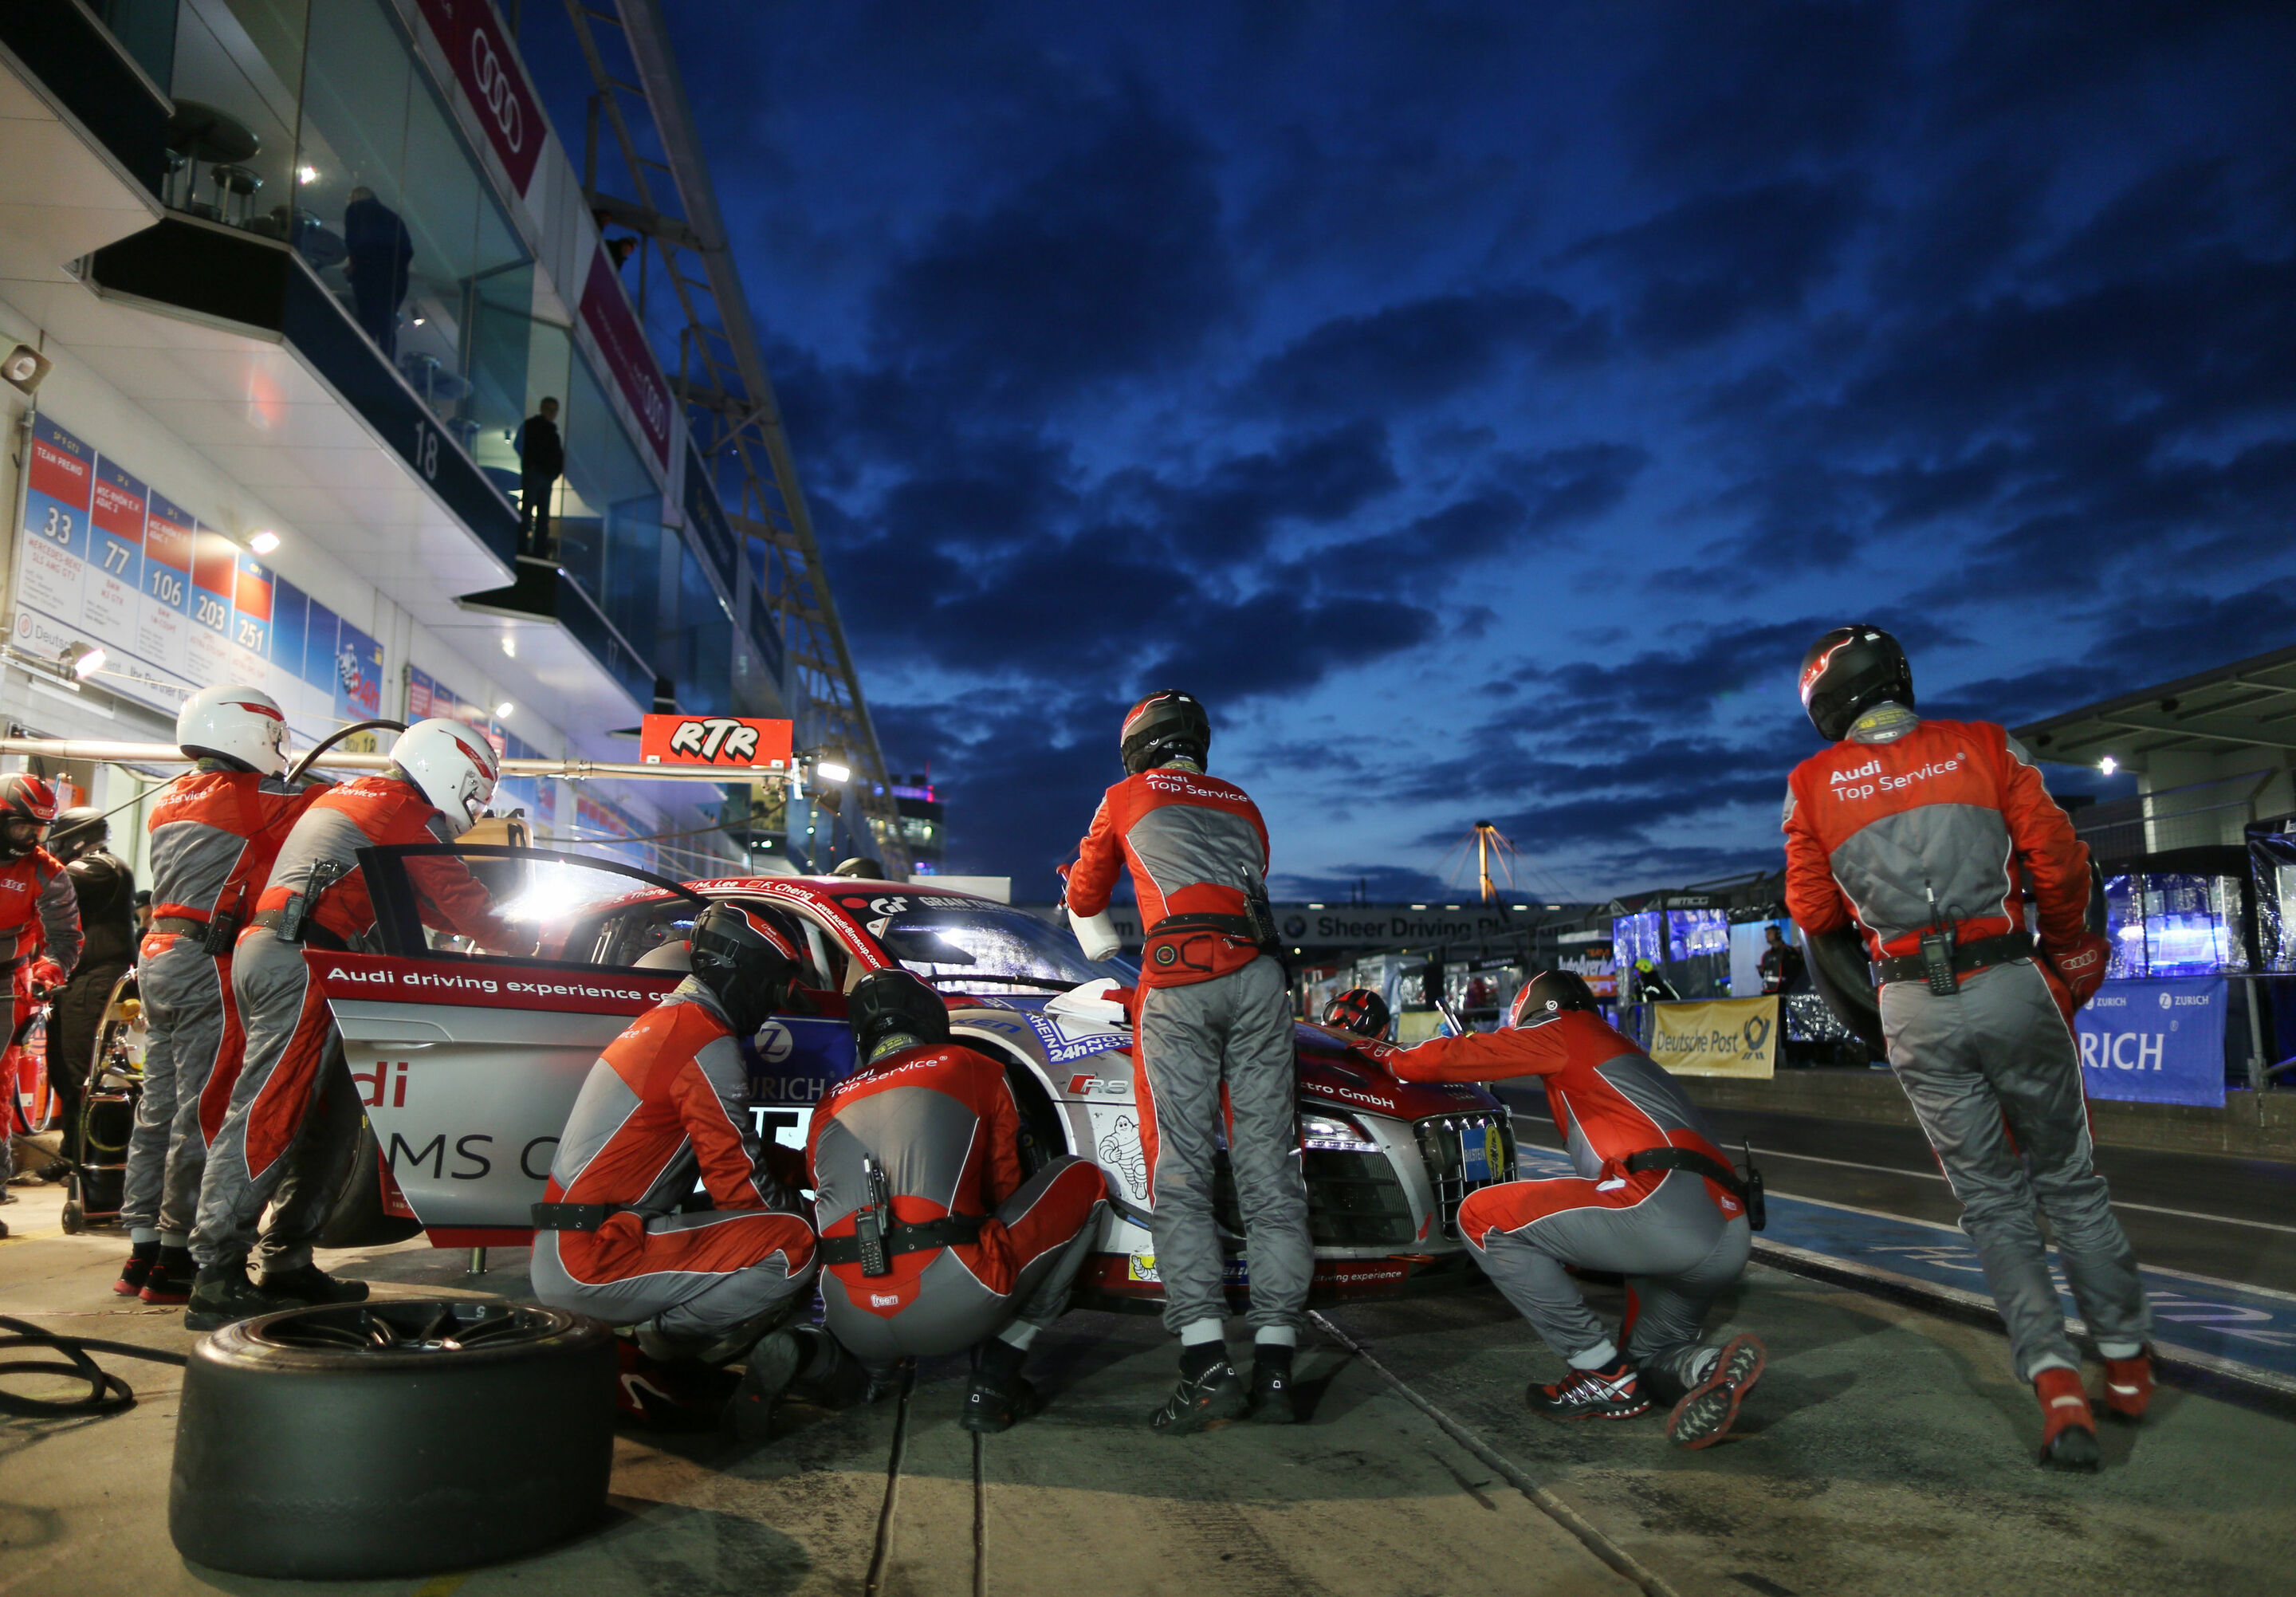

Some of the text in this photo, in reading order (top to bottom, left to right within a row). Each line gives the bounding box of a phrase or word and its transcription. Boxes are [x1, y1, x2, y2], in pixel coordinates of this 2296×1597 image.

[37, 446, 56, 463] TEAM
[416, 420, 438, 480] 18
[44, 506, 73, 545] 33
[104, 540, 130, 575] 77
[153, 569, 182, 606] 106
[196, 595, 226, 631] 203
[238, 619, 264, 652] 251
[670, 718, 760, 763] RTR
[1146, 773, 1189, 783] Audi
[1830, 760, 1882, 785] Audi
[1146, 781, 1248, 802] Top Service
[1831, 785, 1874, 801] Top
[694, 879, 711, 889] M.
[713, 879, 738, 888] Lee
[774, 883, 815, 900] Cheng
[918, 897, 966, 907] GRAN
[816, 901, 882, 970] www.audir8lmscup.com
[1318, 918, 1386, 938] Sheer
[1392, 918, 1471, 942] Driving
[327, 967, 394, 983] Audi
[403, 972, 498, 993] driving
[506, 981, 642, 1001] experience
[2097, 997, 2127, 1007] ZURICH
[2175, 995, 2209, 1006] ZURICH
[760, 1028, 786, 1055] Z
[1657, 1029, 1738, 1052] Deutsche Post
[2080, 1032, 2164, 1071] RICH
[1050, 1044, 1087, 1062] 24h
[830, 1081, 860, 1098] Top
[832, 1068, 875, 1091] Audi
[1082, 1079, 1129, 1095] R8
[1339, 1088, 1395, 1109] GmbH
[388, 1132, 493, 1180] MS
[1464, 1147, 1486, 1162] BILSTEIN
[1314, 1269, 1402, 1283] driving experience
[871, 1294, 899, 1308] freem
